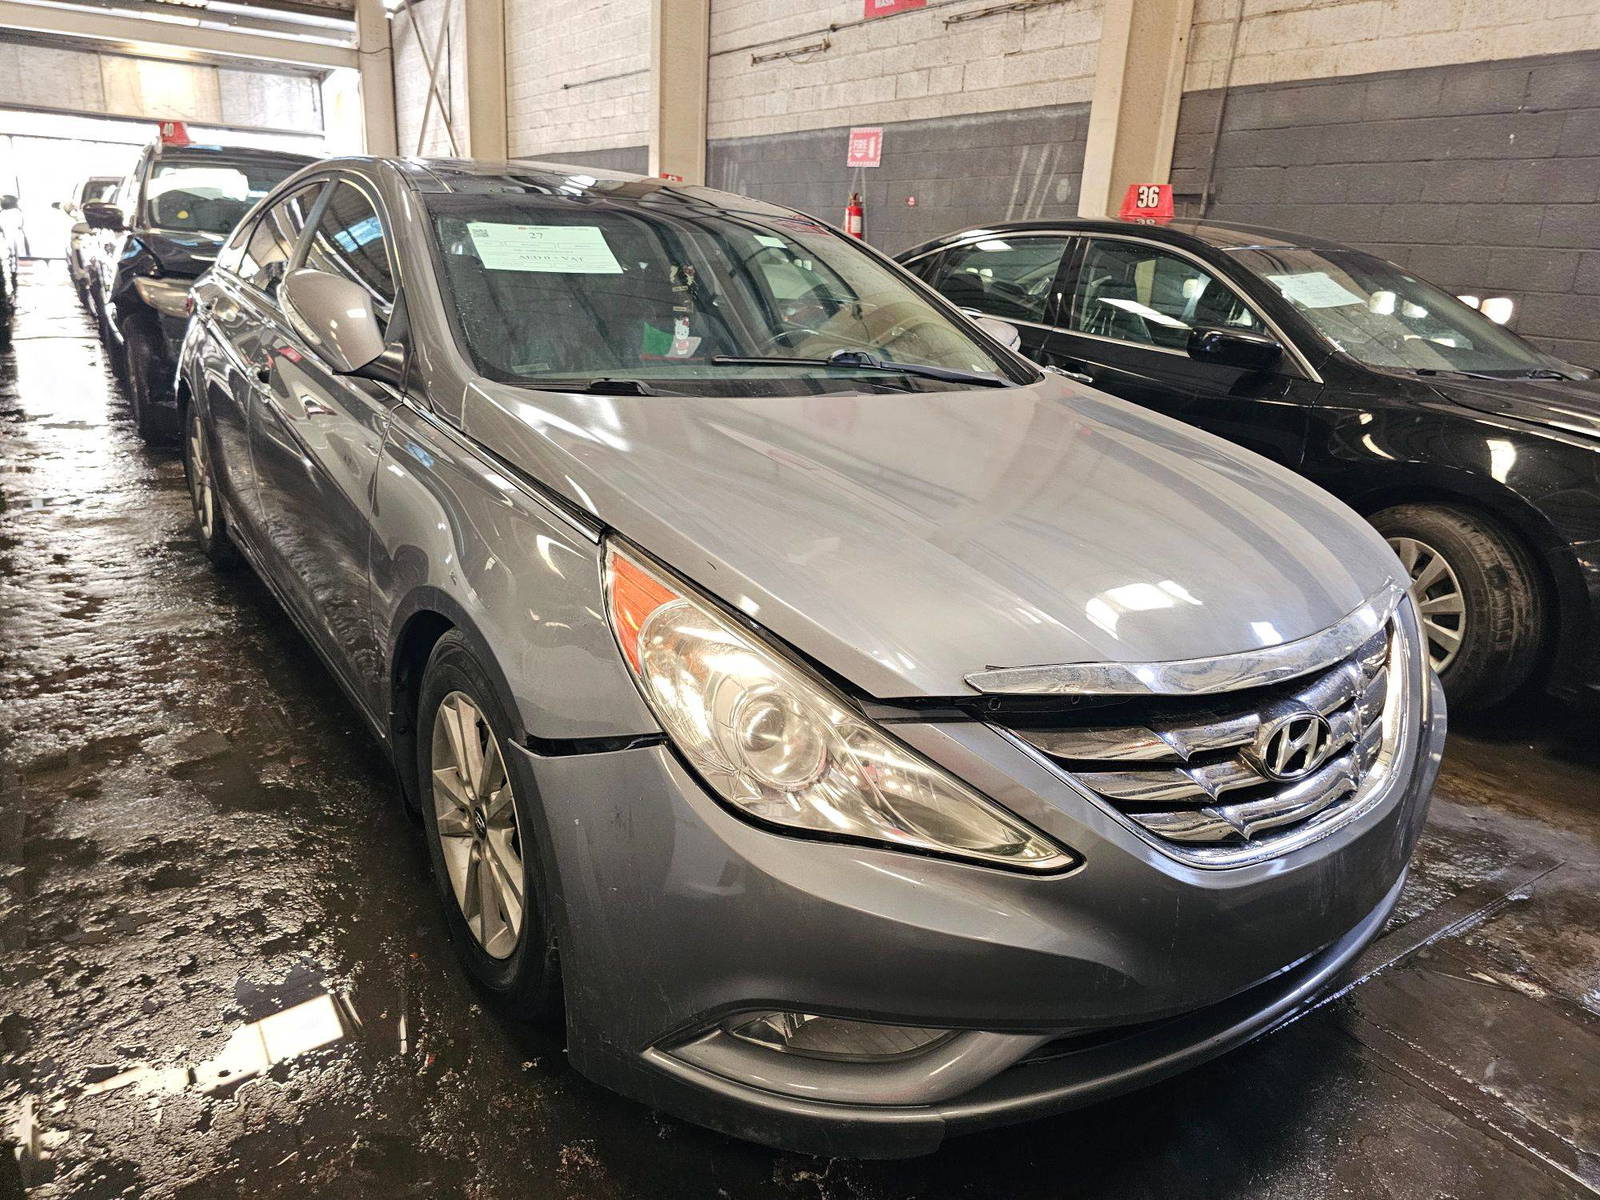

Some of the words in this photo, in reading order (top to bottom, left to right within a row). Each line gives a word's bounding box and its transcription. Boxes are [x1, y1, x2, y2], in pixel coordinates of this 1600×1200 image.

[163, 122, 174, 137] 40
[1137, 185, 1160, 208] 36
[528, 231, 543, 239] 27
